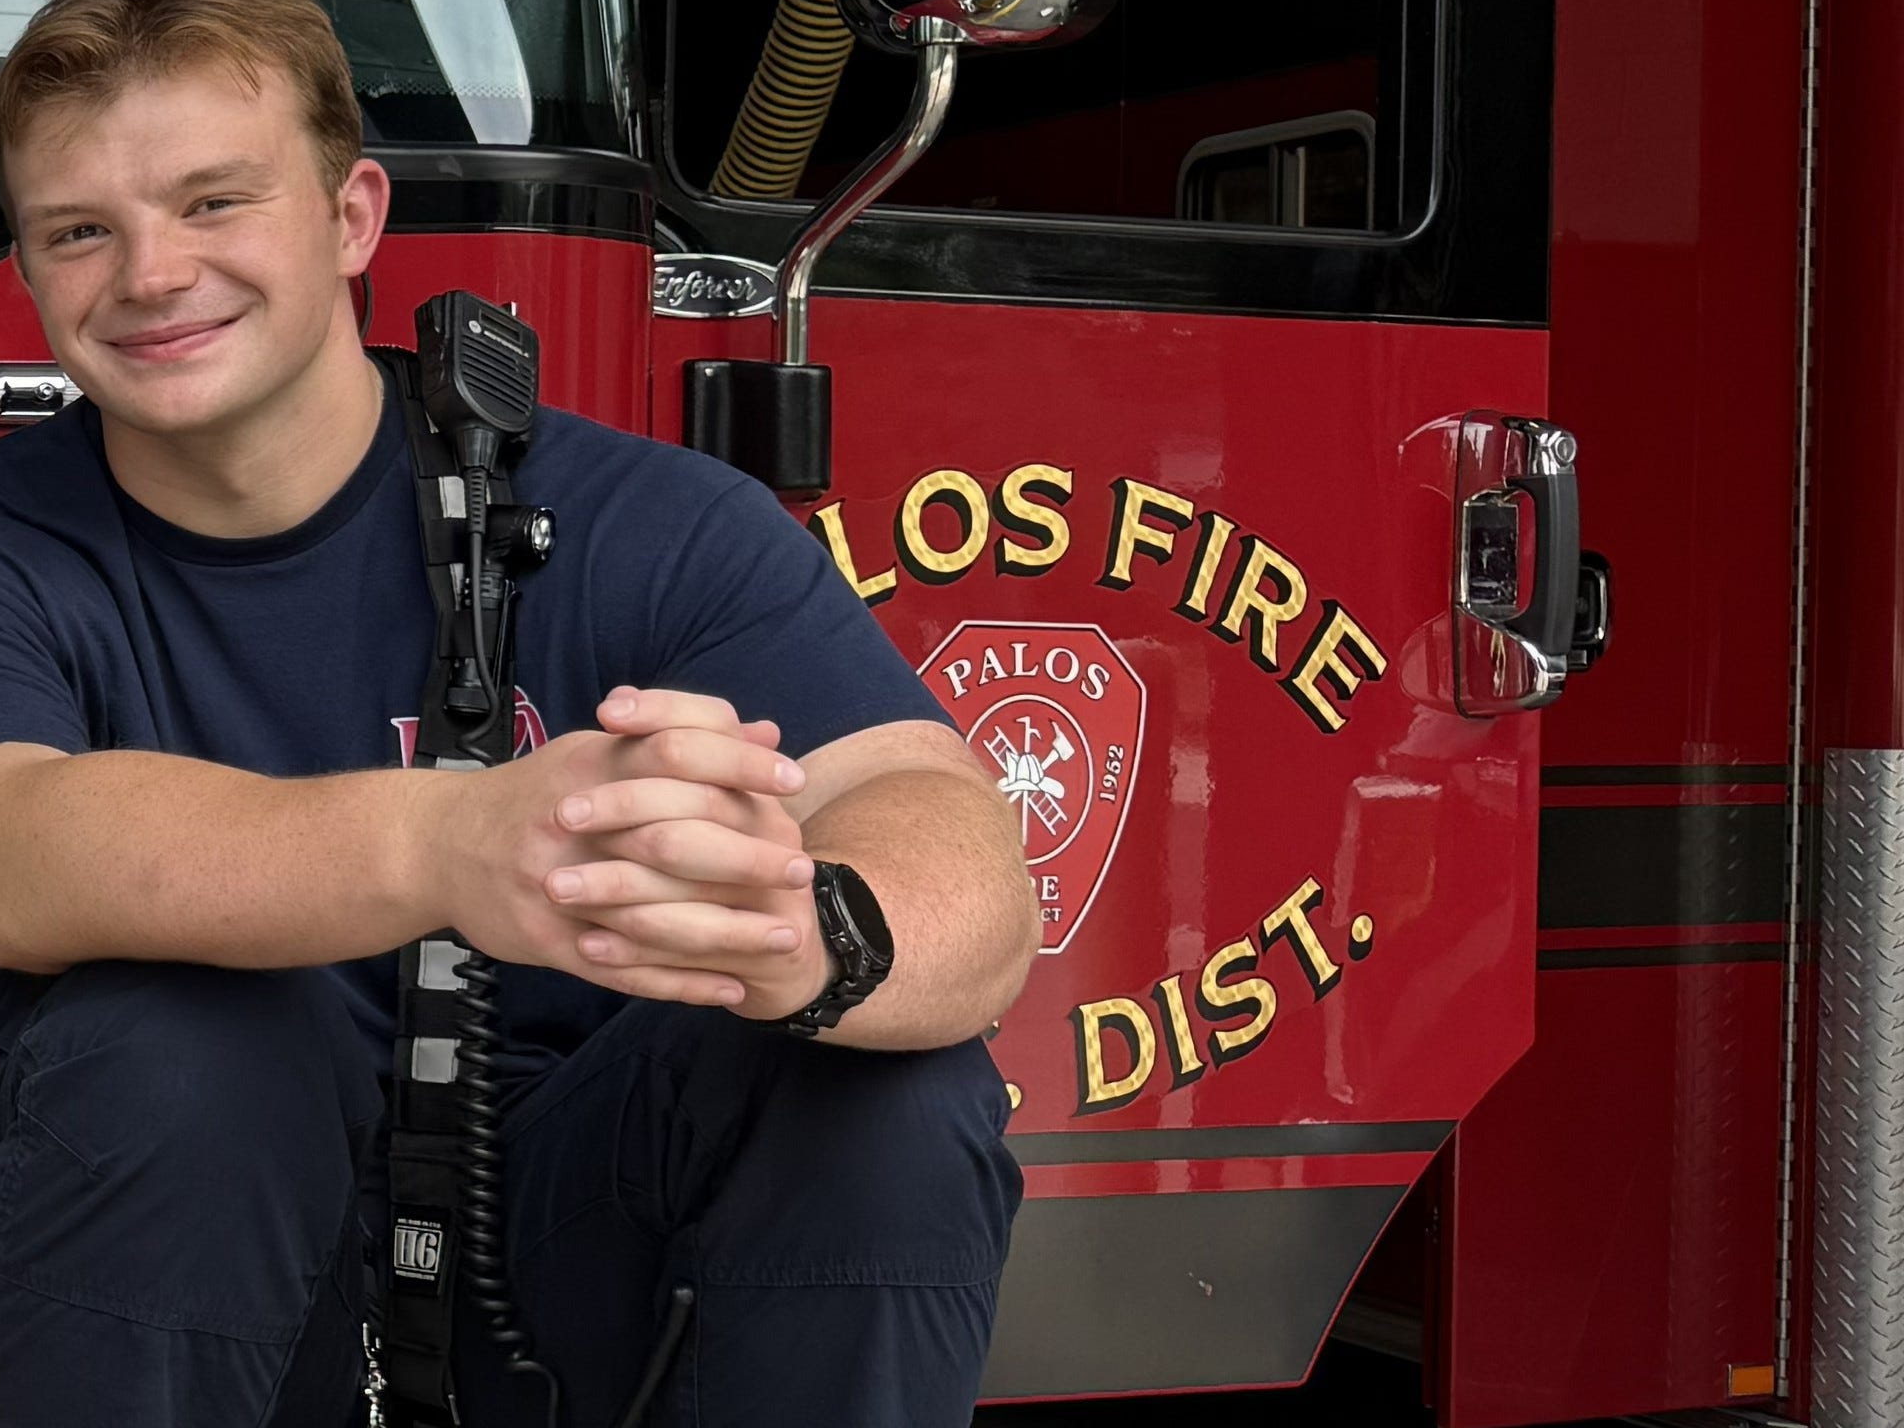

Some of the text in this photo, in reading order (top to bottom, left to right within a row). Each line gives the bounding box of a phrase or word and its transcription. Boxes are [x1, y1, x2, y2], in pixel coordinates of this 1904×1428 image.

[942, 642, 1111, 700] PALOS
[1097, 474, 1389, 734] FIRE
[1071, 876, 1377, 1117] DIST.
